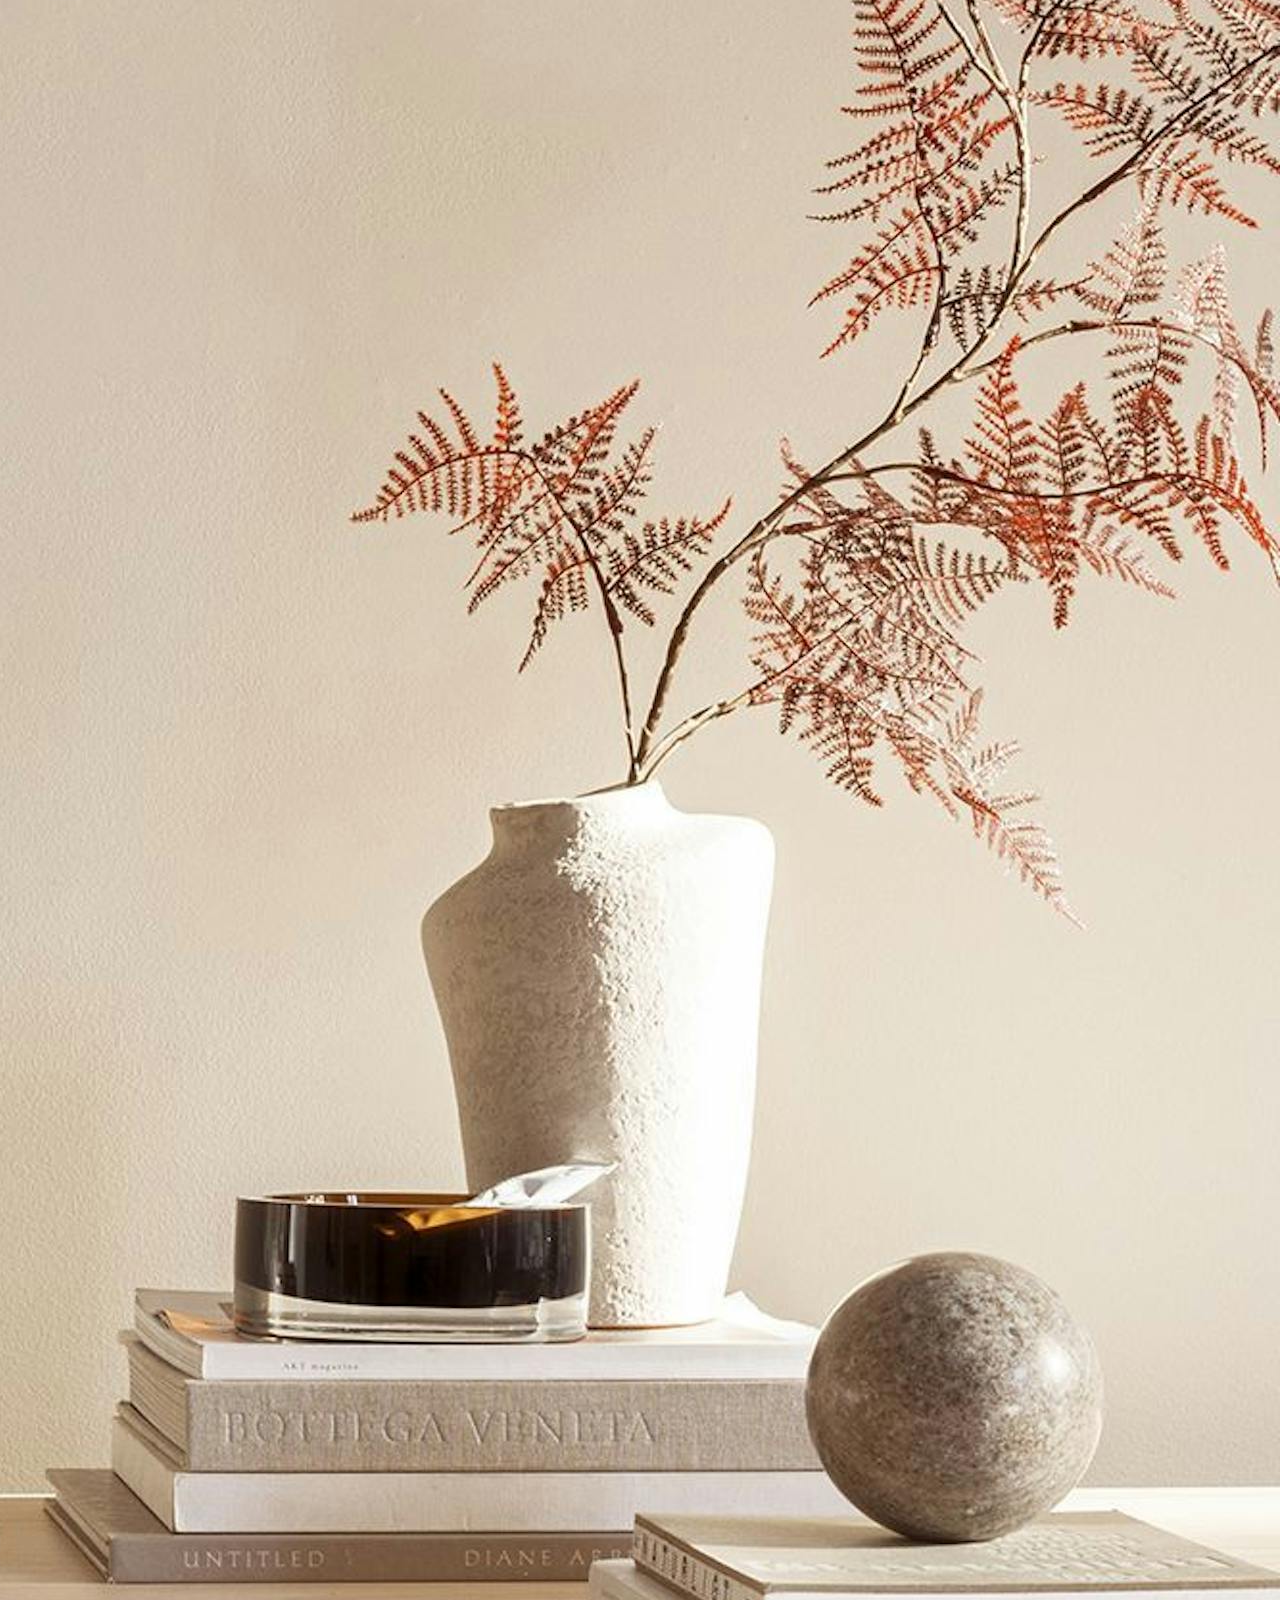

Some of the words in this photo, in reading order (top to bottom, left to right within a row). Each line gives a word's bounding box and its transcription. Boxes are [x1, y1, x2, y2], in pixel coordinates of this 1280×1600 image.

[223, 1410, 448, 1444] BOTTEGA
[465, 1410, 656, 1445] VENETA
[183, 1550, 326, 1569] UNTITLED
[464, 1549, 552, 1567] DIANE
